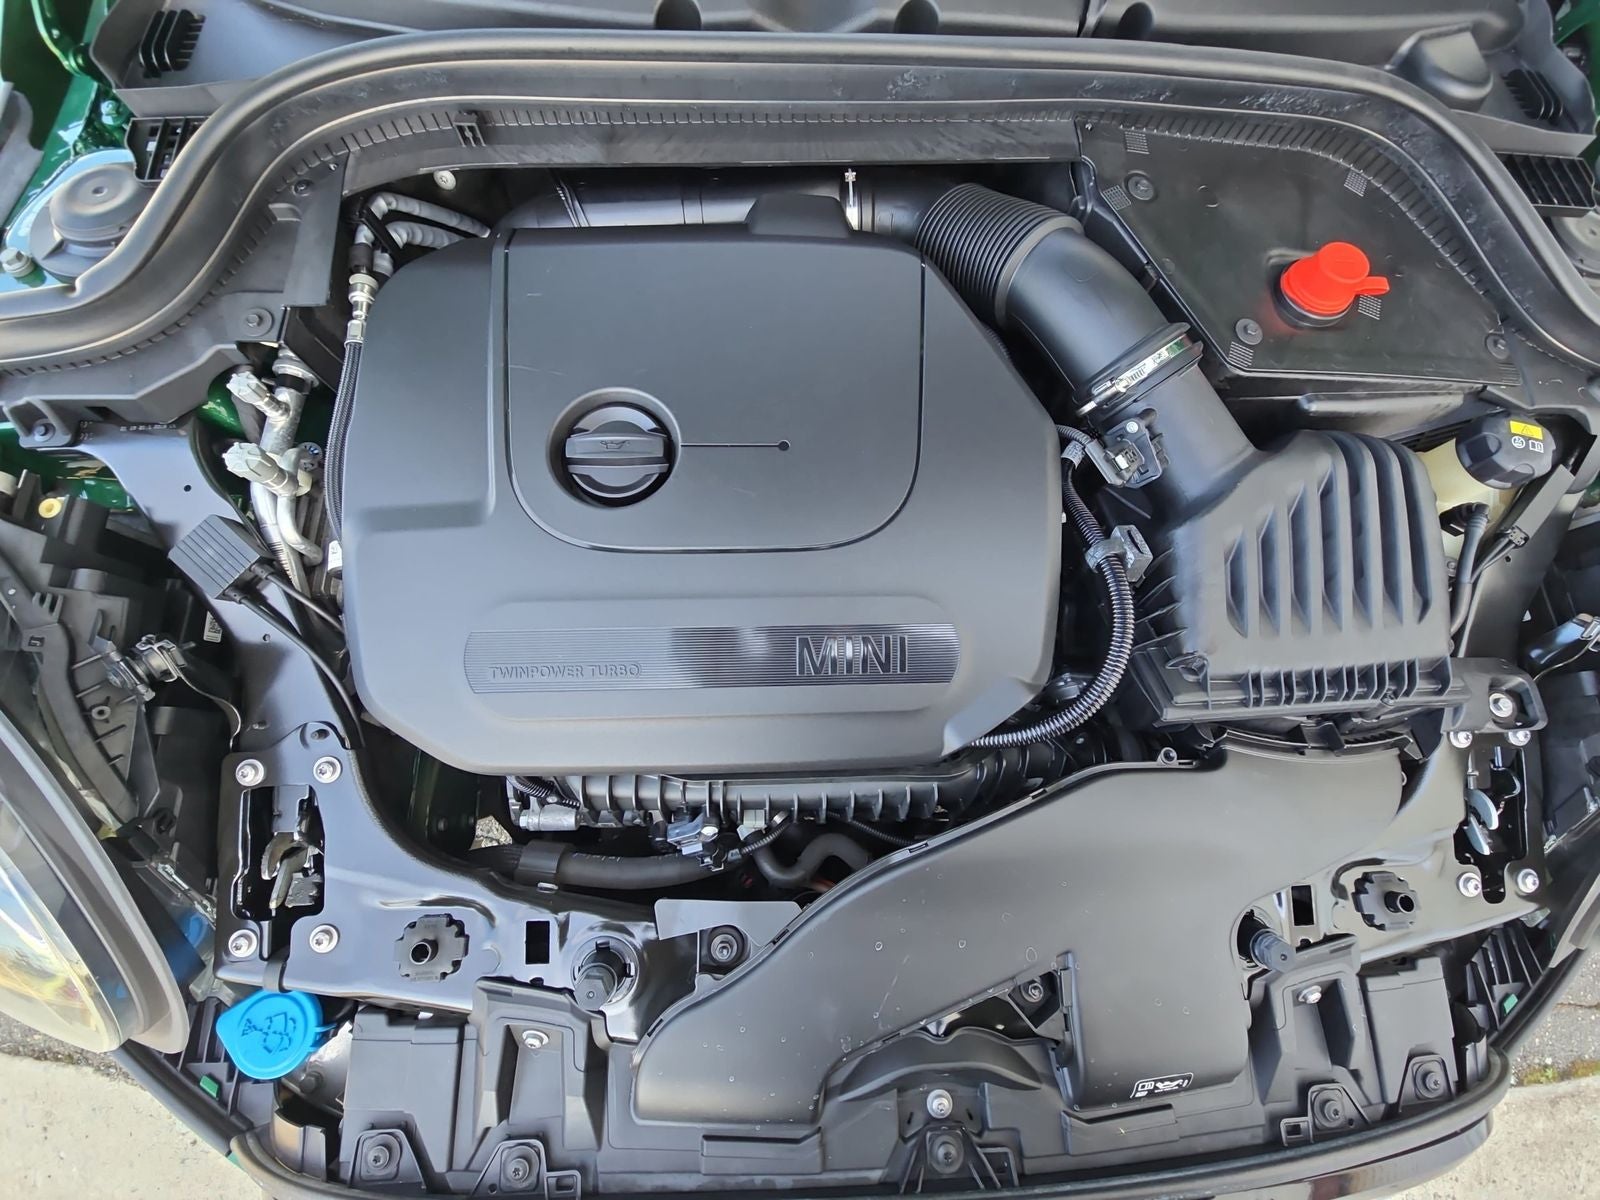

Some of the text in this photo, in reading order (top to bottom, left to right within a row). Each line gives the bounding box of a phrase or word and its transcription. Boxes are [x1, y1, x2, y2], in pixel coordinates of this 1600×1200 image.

[796, 634, 909, 676] MINI
[488, 662, 642, 680] TWINPOWER TURBO
